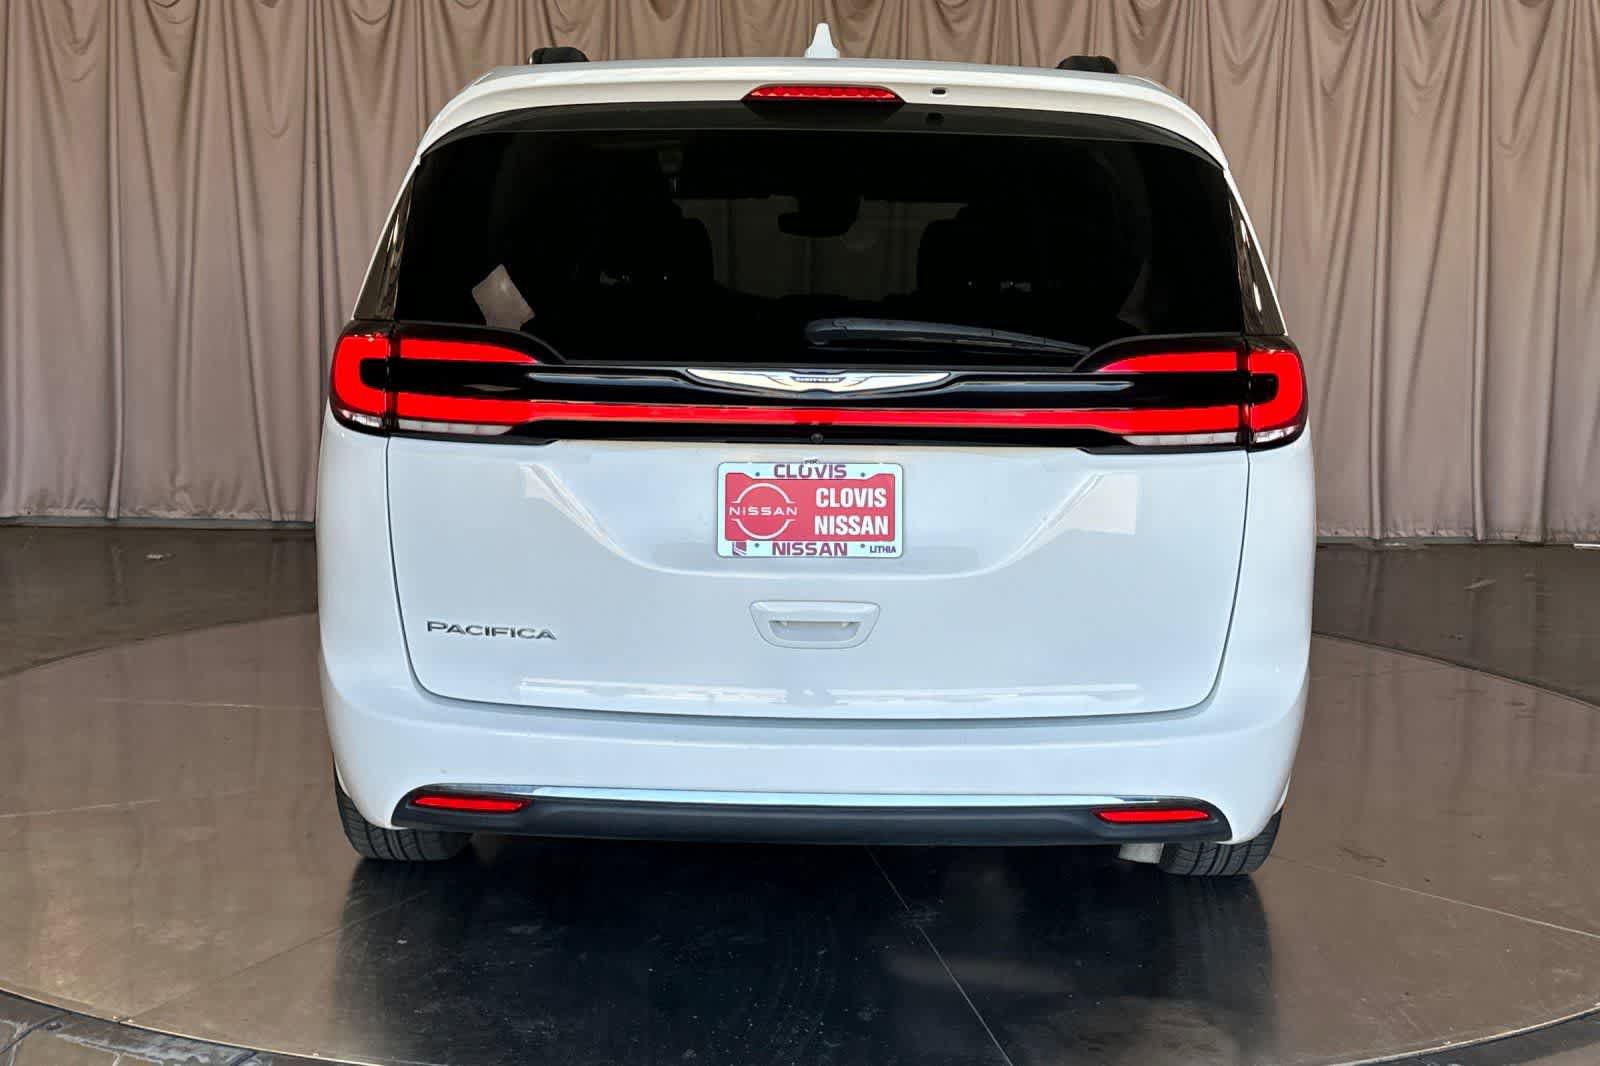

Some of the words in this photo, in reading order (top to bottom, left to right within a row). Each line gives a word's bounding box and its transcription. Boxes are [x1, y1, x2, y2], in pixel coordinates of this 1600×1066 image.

[773, 464, 847, 479] CLOVIS
[815, 487, 887, 508] CLOVIS
[728, 506, 798, 516] NISSAN
[814, 515, 889, 535] NISSAN
[772, 542, 848, 556] NISSAN
[869, 545, 896, 554] LITHIA
[426, 620, 557, 640] PACIFICA
